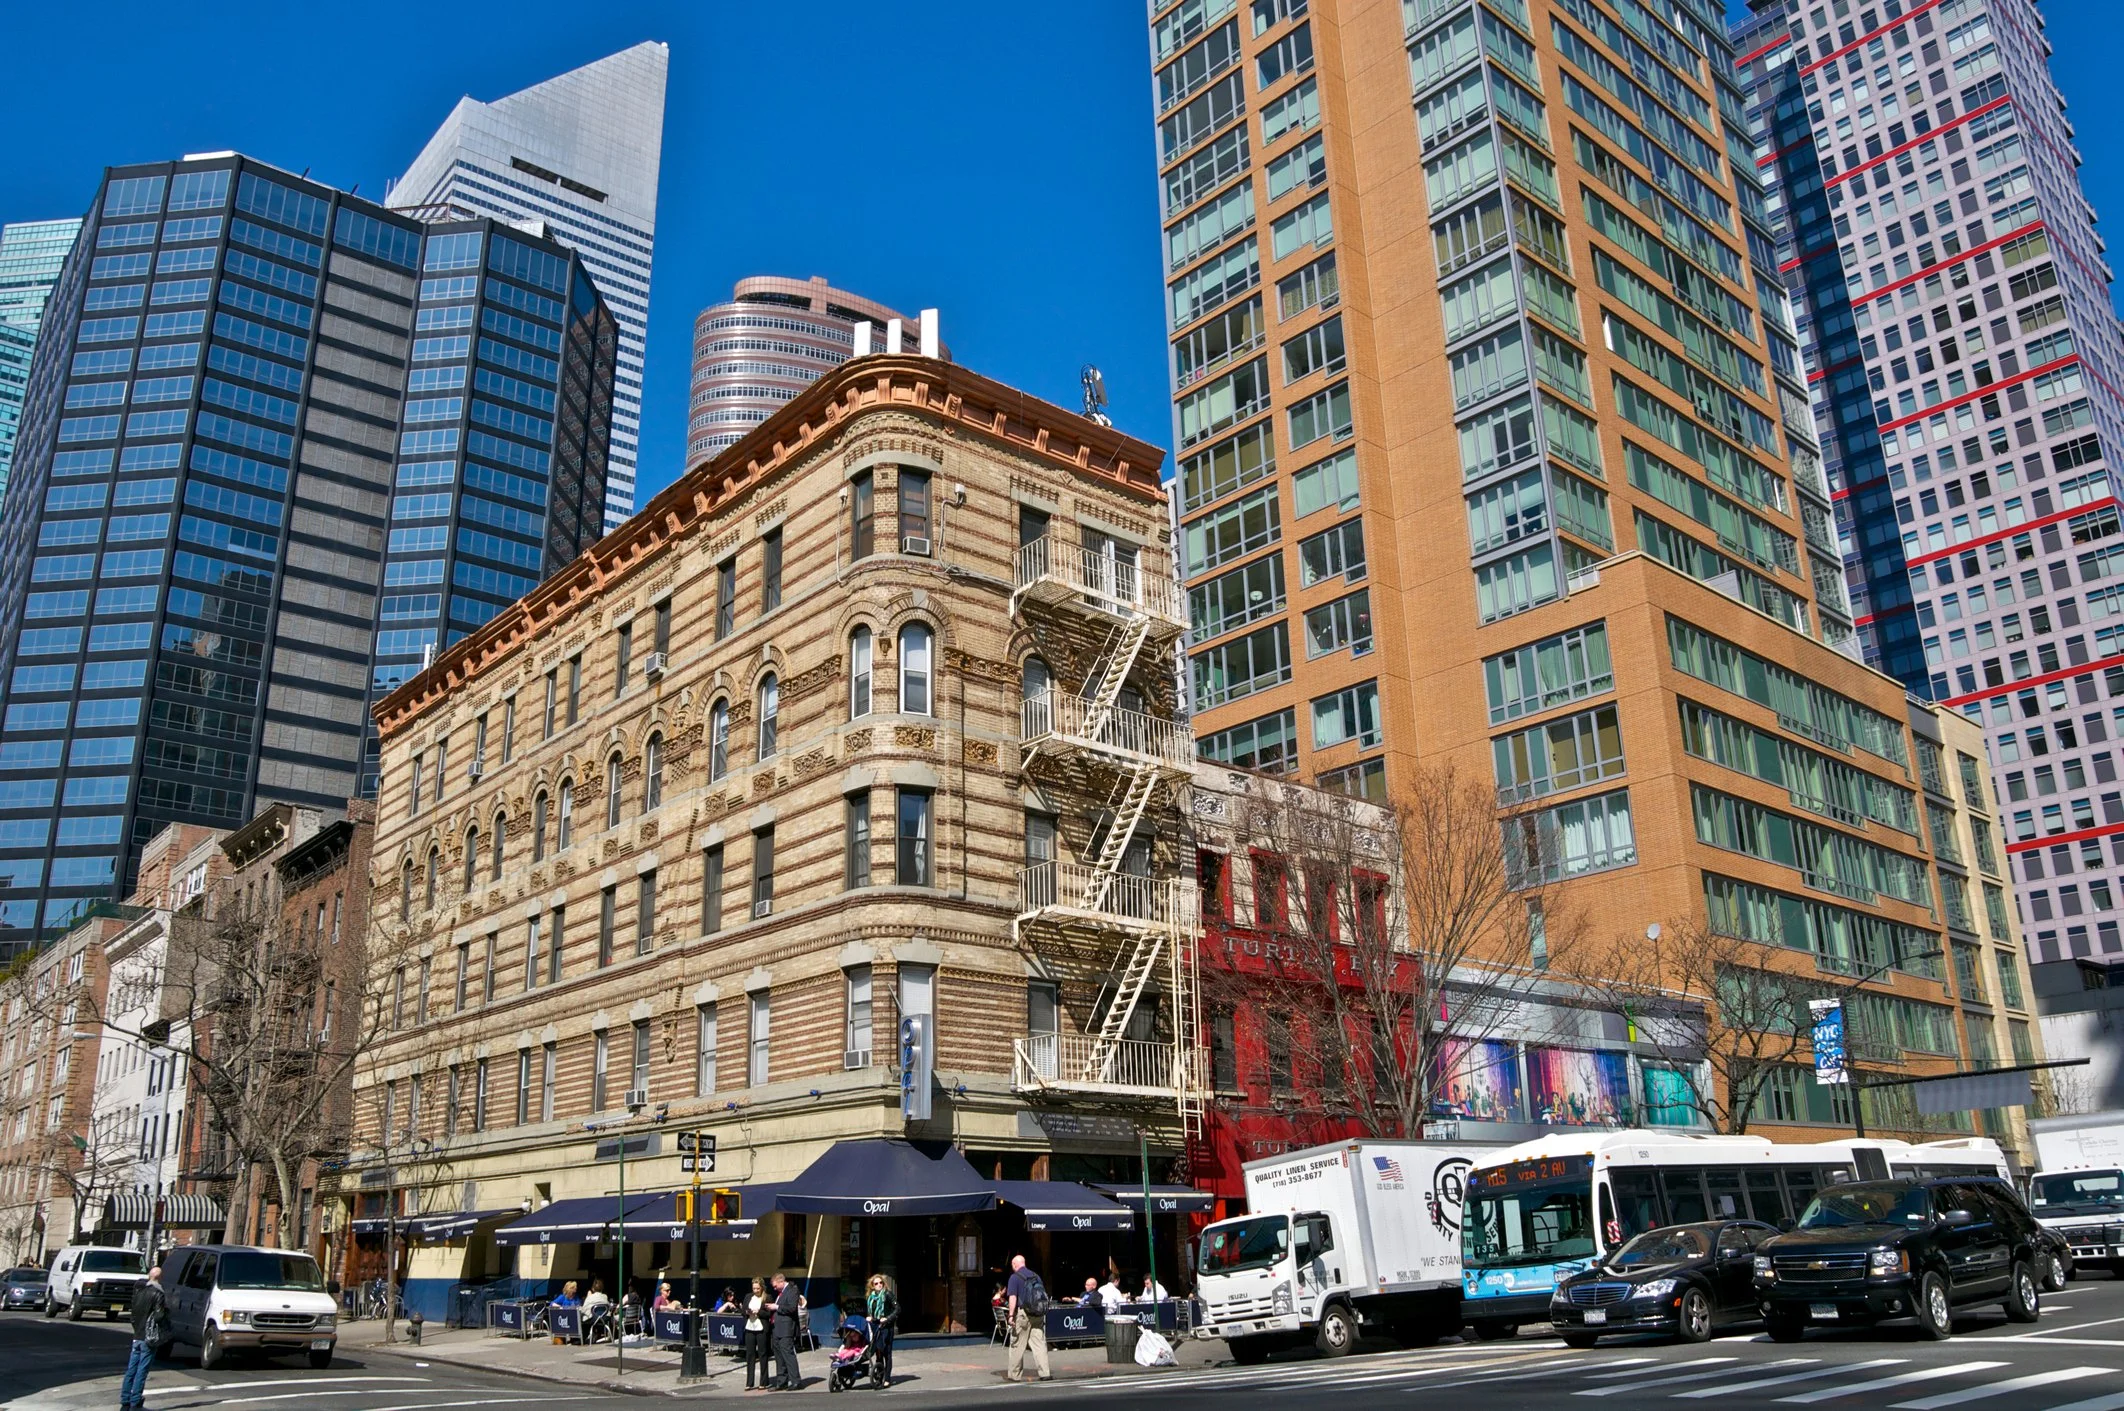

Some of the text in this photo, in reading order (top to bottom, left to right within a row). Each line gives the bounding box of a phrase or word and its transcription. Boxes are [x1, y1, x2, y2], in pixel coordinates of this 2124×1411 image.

[1814, 1024, 1838, 1040] NYC
[1255, 1170, 1282, 1183] QUALITY
[1286, 1164, 1306, 1175] LINEN
[1310, 1157, 1339, 1170] SERVICE
[1518, 1170, 1537, 1181] VIA
[1540, 1163, 1548, 1178] 2
[1551, 1161, 1566, 1177] AV
[1288, 1171, 1322, 1184] 353-8677
[863, 1200, 890, 1214] Opal
[1159, 1198, 1176, 1210] Opal
[1072, 1216, 1092, 1229] Opal
[670, 1228, 684, 1240] Opal
[1439, 1255, 1460, 1266] STAN
[1485, 1275, 1503, 1285] 1250
[1063, 1316, 1084, 1330] Opal
[1137, 1311, 1156, 1324] Opal
[666, 1320, 680, 1333] Opal
[720, 1324, 734, 1337] Opal
